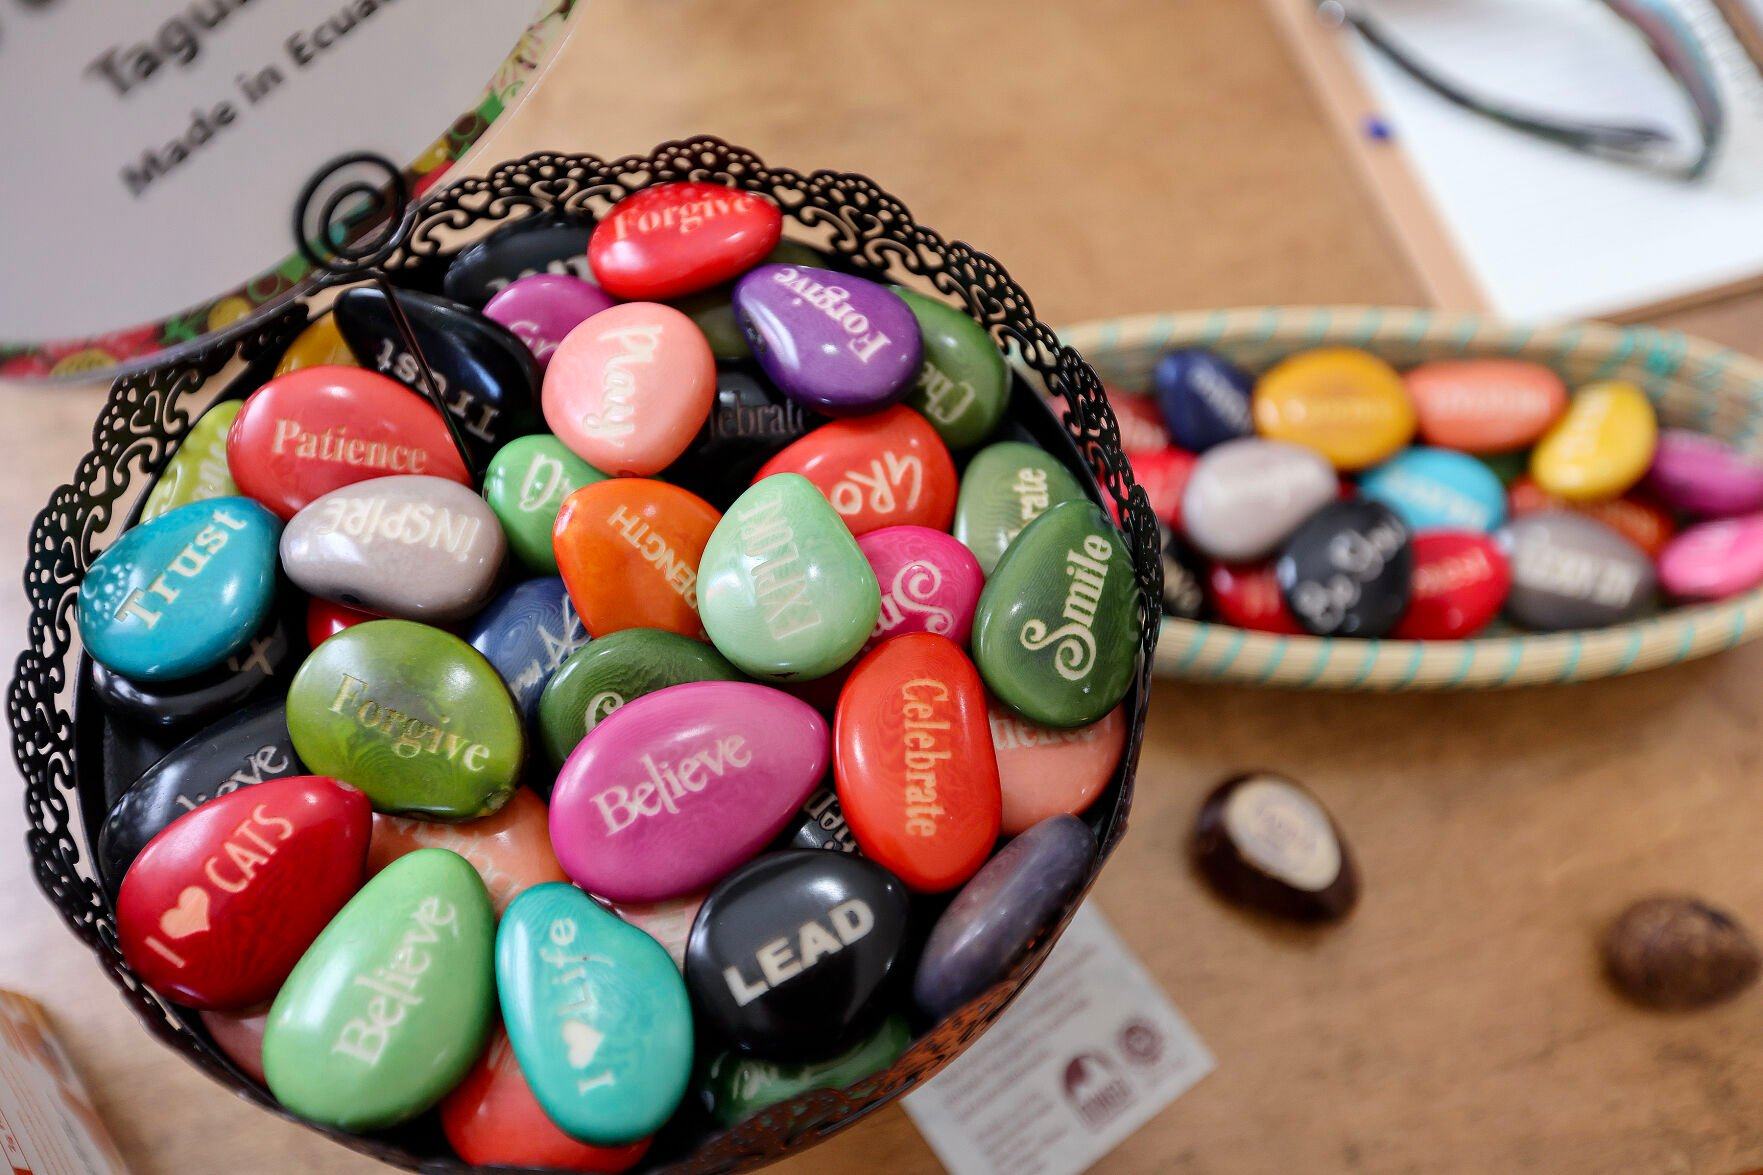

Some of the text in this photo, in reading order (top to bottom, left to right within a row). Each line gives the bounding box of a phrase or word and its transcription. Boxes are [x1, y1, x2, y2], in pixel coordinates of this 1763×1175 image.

[90, 0, 248, 96] Tagu
[120, 0, 392, 196] Made in Ecua
[613, 195, 753, 241] Forgive
[773, 265, 892, 364] Forgive
[271, 418, 429, 474] Patience
[829, 450, 924, 516] GRO
[114, 509, 247, 631] Trust
[606, 505, 700, 610] ENGTH
[1020, 534, 1113, 681] Smile
[328, 673, 490, 772] Forgive
[901, 677, 951, 838] Celebrate
[588, 733, 753, 836] Believe
[145, 803, 294, 969] I CATS
[332, 895, 459, 1068] Believe
[721, 898, 876, 1007] LEAD
[539, 917, 615, 1096] I Life
